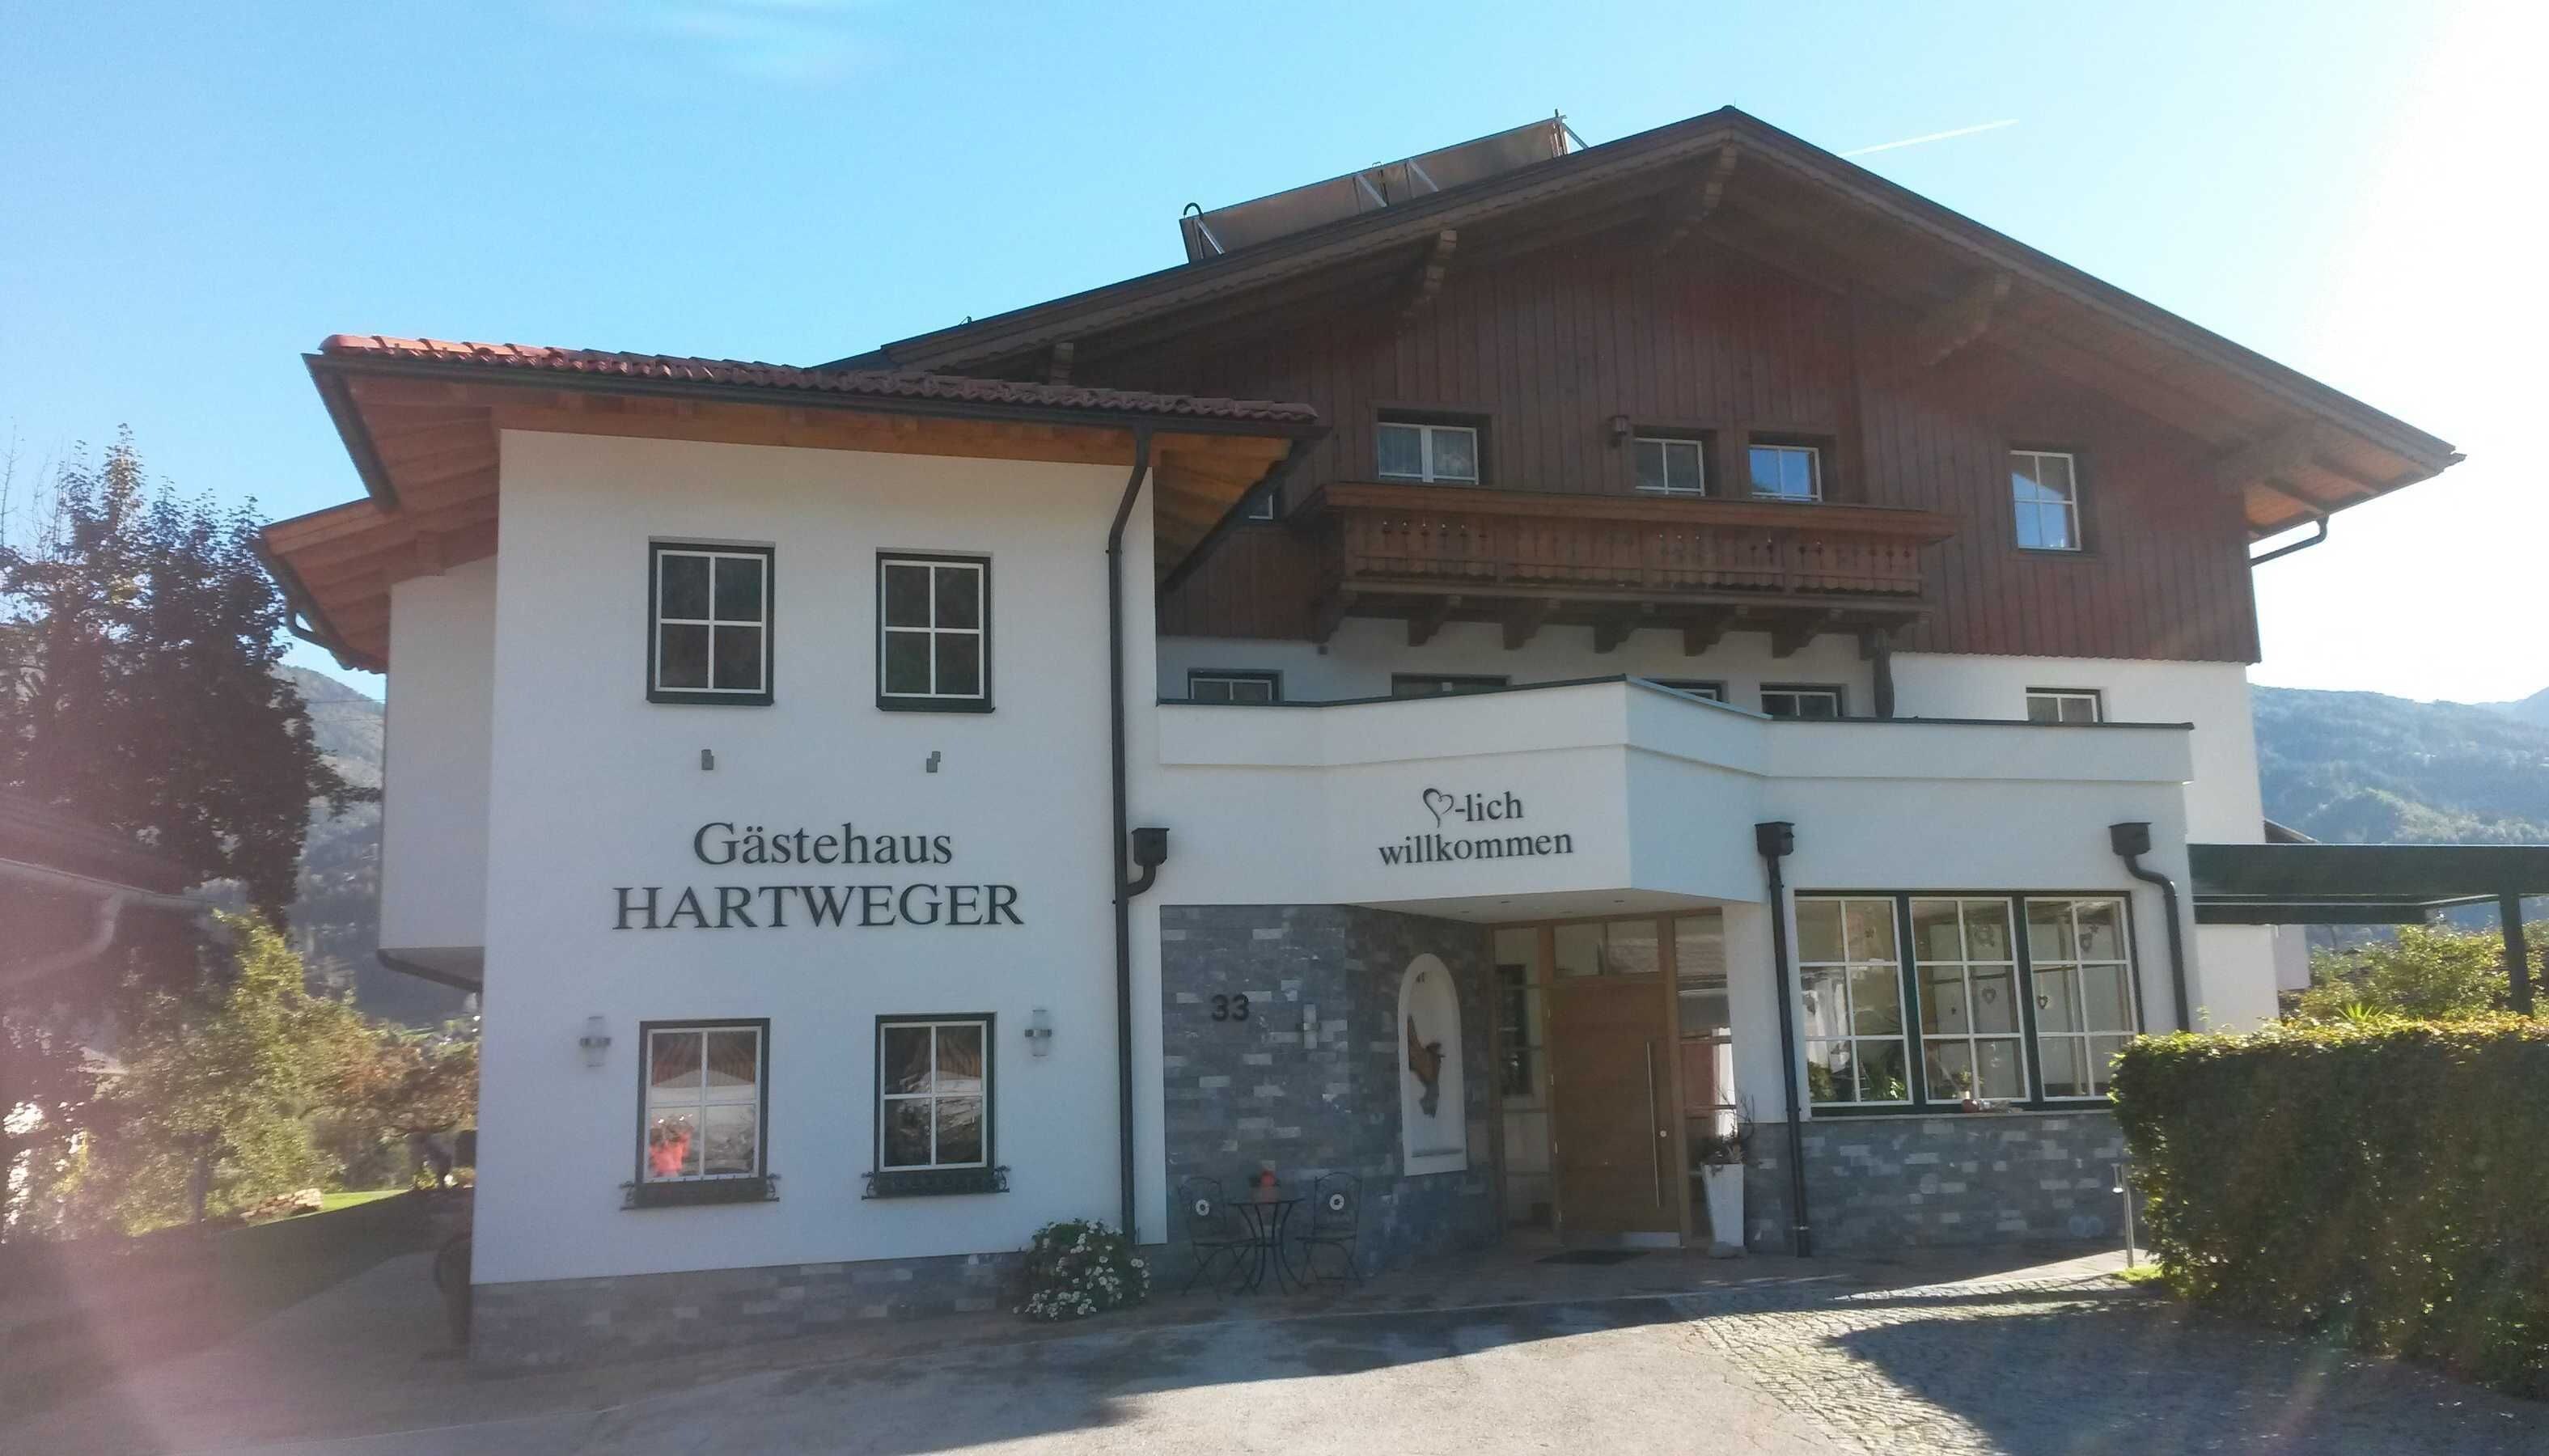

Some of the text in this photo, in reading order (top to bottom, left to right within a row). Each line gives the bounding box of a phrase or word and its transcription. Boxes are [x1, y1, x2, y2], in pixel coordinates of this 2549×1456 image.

[693, 822, 953, 866] Gästehaus
[1378, 833, 1574, 867] willkommen
[612, 882, 1025, 930] HARTWEGER
[1212, 993, 1250, 1022] 33
